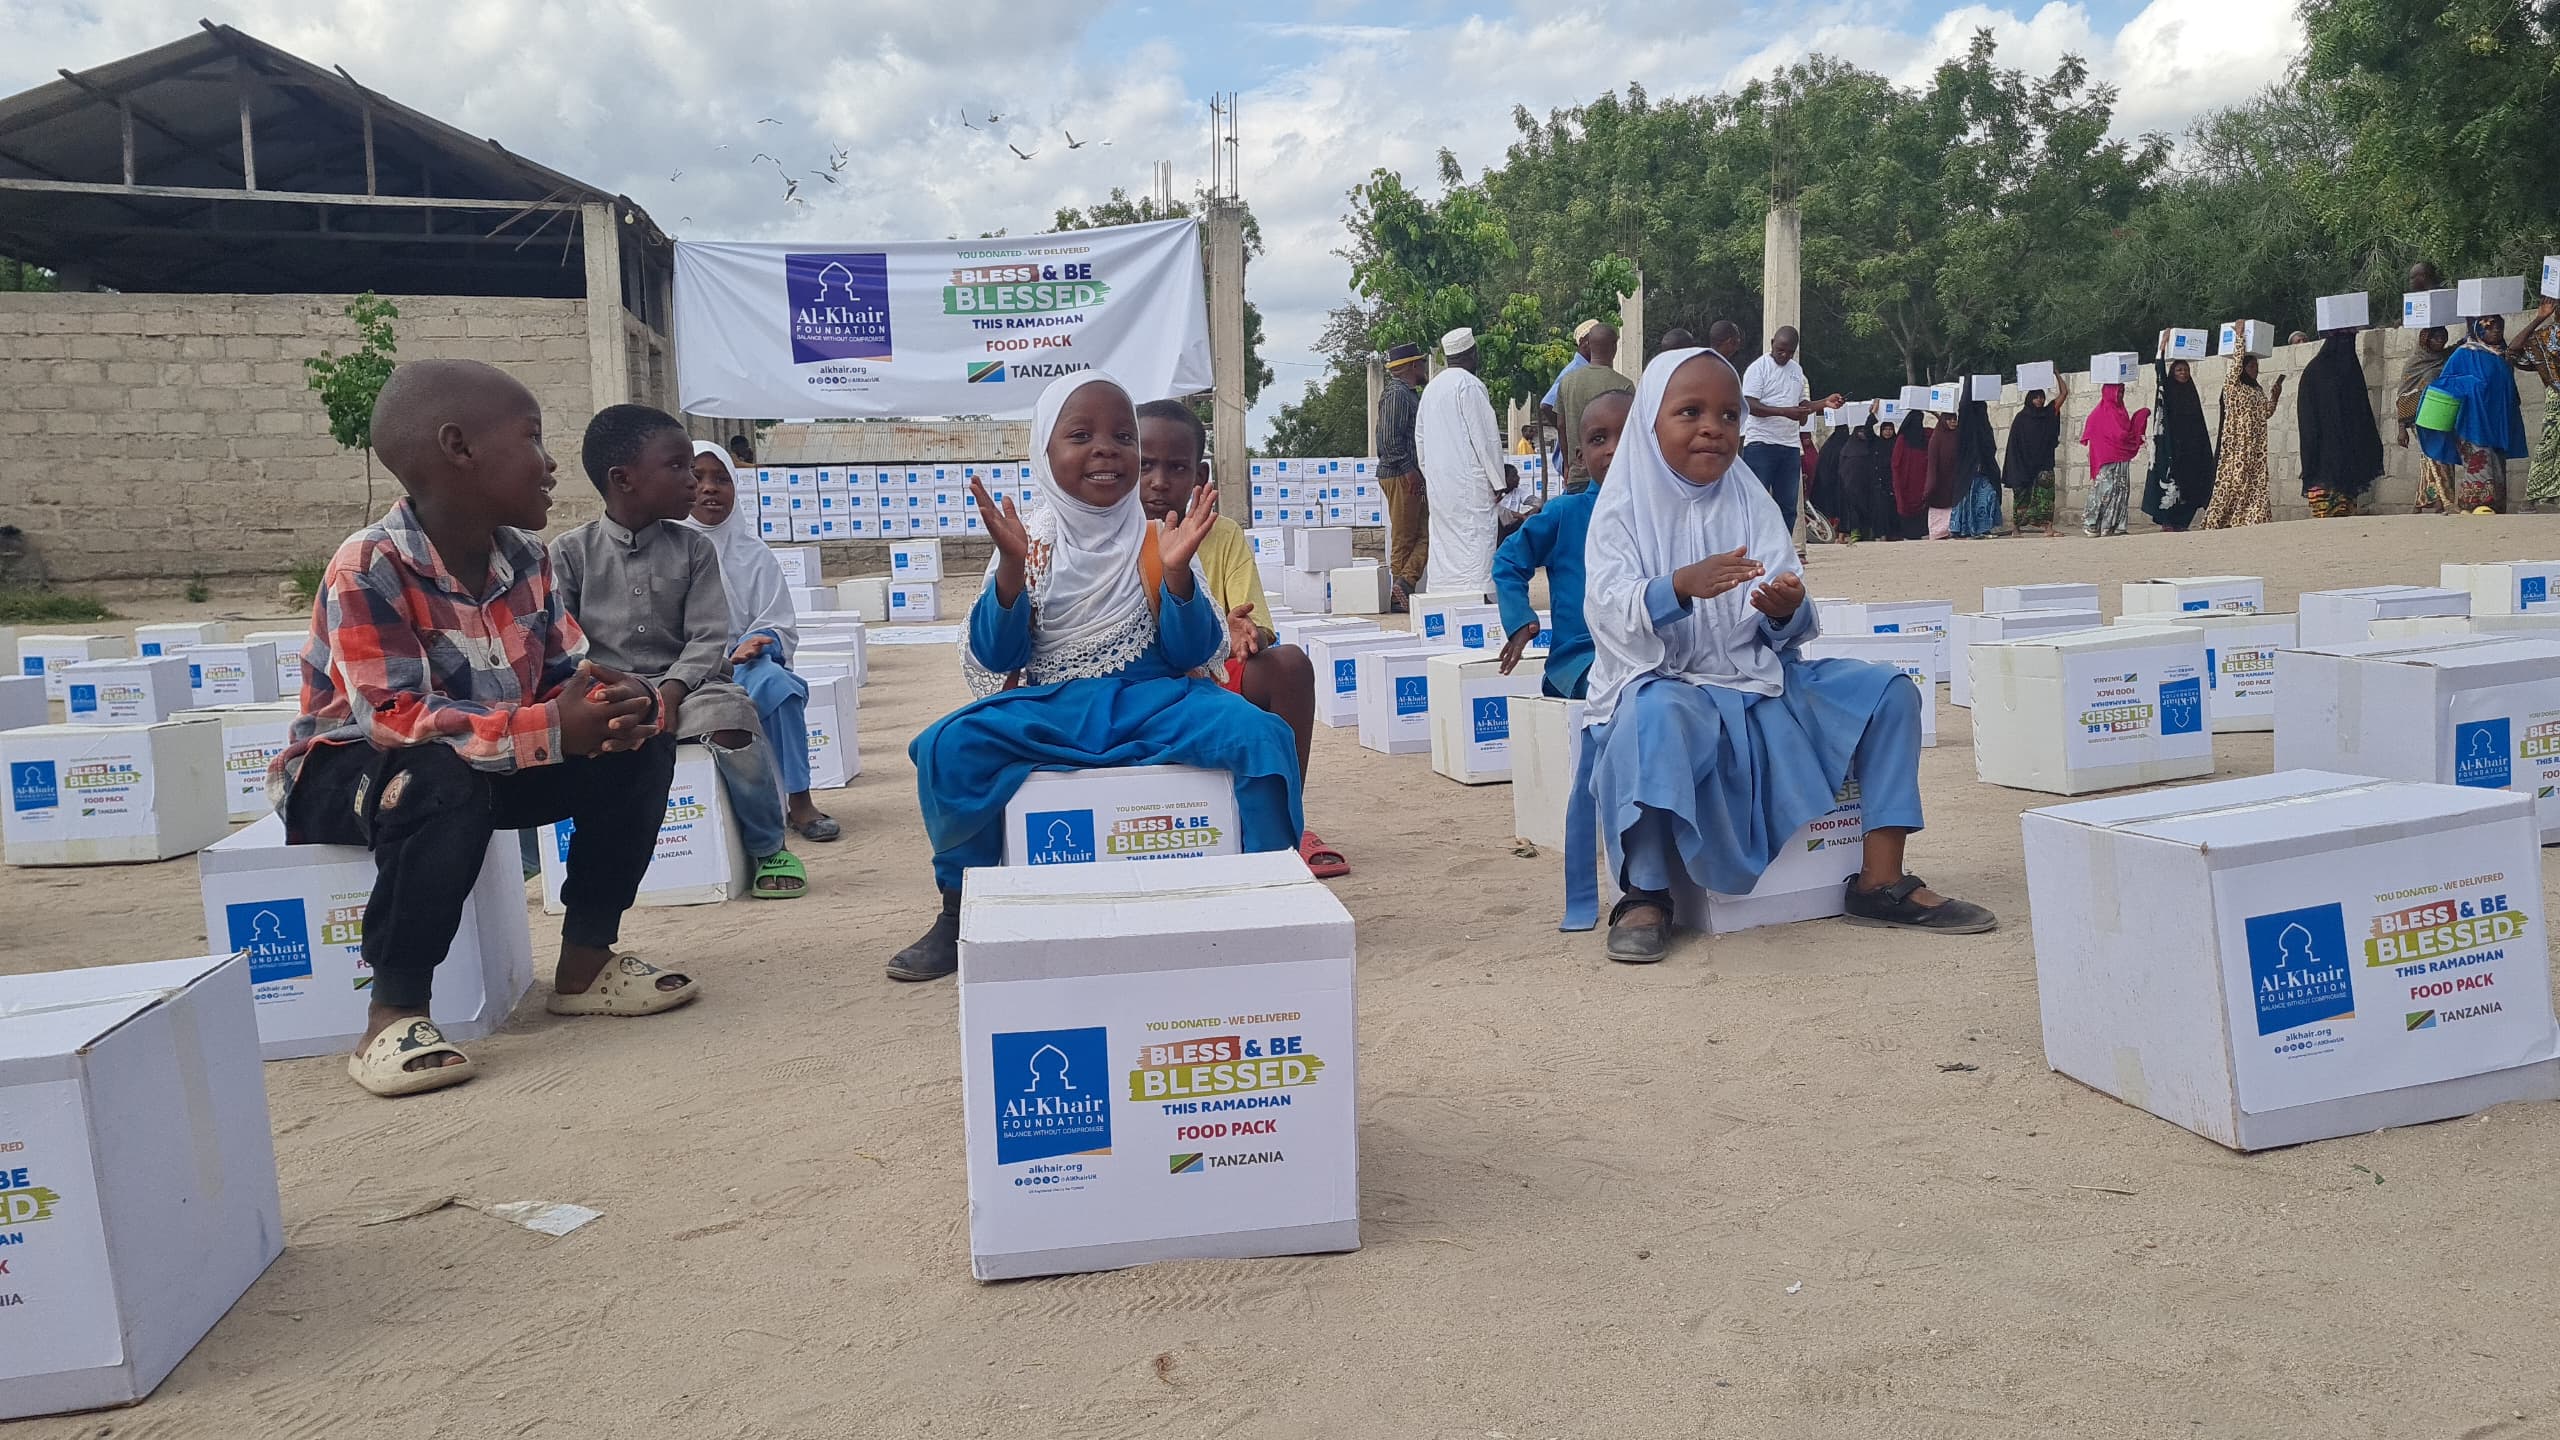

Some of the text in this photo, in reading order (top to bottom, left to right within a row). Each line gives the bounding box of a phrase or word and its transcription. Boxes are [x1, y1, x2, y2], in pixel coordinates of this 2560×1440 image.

[957, 251, 977, 259] YOU
[978, 250, 1022, 258] DONATED
[1044, 246, 1090, 255] DELIVERED
[961, 263, 1092, 283] BLESS & BE
[955, 285, 1095, 311] BLESSED
[796, 306, 884, 324] Al-Khair
[972, 314, 1083, 330] THIS RAMADHAN
[796, 325, 885, 335] FOUNDATION
[986, 334, 1072, 352] FOOD PACK
[820, 365, 867, 375] alkhair.org
[2228, 653, 2255, 661] BLESS
[2226, 660, 2273, 672] BLESSE
[2097, 689, 2114, 697] PACK
[2086, 706, 2148, 723] BLESSED
[2088, 724, 2100, 733] BE
[2115, 719, 2145, 730] BLESS
[2530, 723, 2560, 737] BLES
[231, 758, 271, 769] BLESS
[2458, 755, 2508, 771] Al-Khair
[2536, 757, 2552, 765] THIS
[70, 774, 135, 787] BLESSED
[2543, 770, 2560, 781] FOO
[668, 796, 695, 807] & BE
[660, 824, 693, 832] MADHAN
[1119, 816, 1209, 832] BLESS & BE
[1809, 816, 1860, 832] FOOD PACK
[666, 835, 688, 844] PACK
[1115, 830, 1211, 852] BLESSED
[656, 850, 693, 859] TANZANIA
[1033, 850, 1092, 864] Al-Khair
[2375, 891, 2395, 902] YOU
[2396, 885, 2438, 899] DONATED
[2443, 881, 2458, 890] WE
[2459, 872, 2504, 888] DELIVERED
[331, 891, 369, 901] YOU DONA
[334, 908, 365, 922] BLE
[2381, 894, 2507, 933] BLESS & BE
[2376, 916, 2514, 962] BLESSED
[240, 941, 305, 956] l-Khair
[251, 953, 306, 964] UNDATION
[2395, 949, 2504, 978] THIS RAMADHAN
[2259, 964, 2344, 993] Al-Khair
[2260, 982, 2346, 1004] FOUNDATION
[2410, 973, 2494, 1000] FOOD PACK
[2440, 1001, 2502, 1023] TANZANIA
[1146, 1022, 1168, 1031] YOU
[1171, 1017, 1221, 1029] DONATED
[1228, 1015, 1245, 1025] WE
[1247, 1011, 1301, 1024] DELIVERED
[2285, 1028, 2332, 1042] alkhair.org
[1150, 1035, 1302, 1065] BLESS & BE
[1143, 1060, 1307, 1097] BLESSED
[1003, 1094, 1103, 1118] Al-Khair
[1162, 1094, 1291, 1115] THIS RAMADHAN
[1003, 1114, 1104, 1129] FOUNDATION
[1033, 1128, 1061, 1136] WITHOUT
[1063, 1126, 1104, 1134] COMPROMISE
[1177, 1119, 1277, 1140] FOOD PACK
[1209, 1151, 1284, 1168] TANZANIA
[1028, 1163, 1083, 1174] alkhair.org
